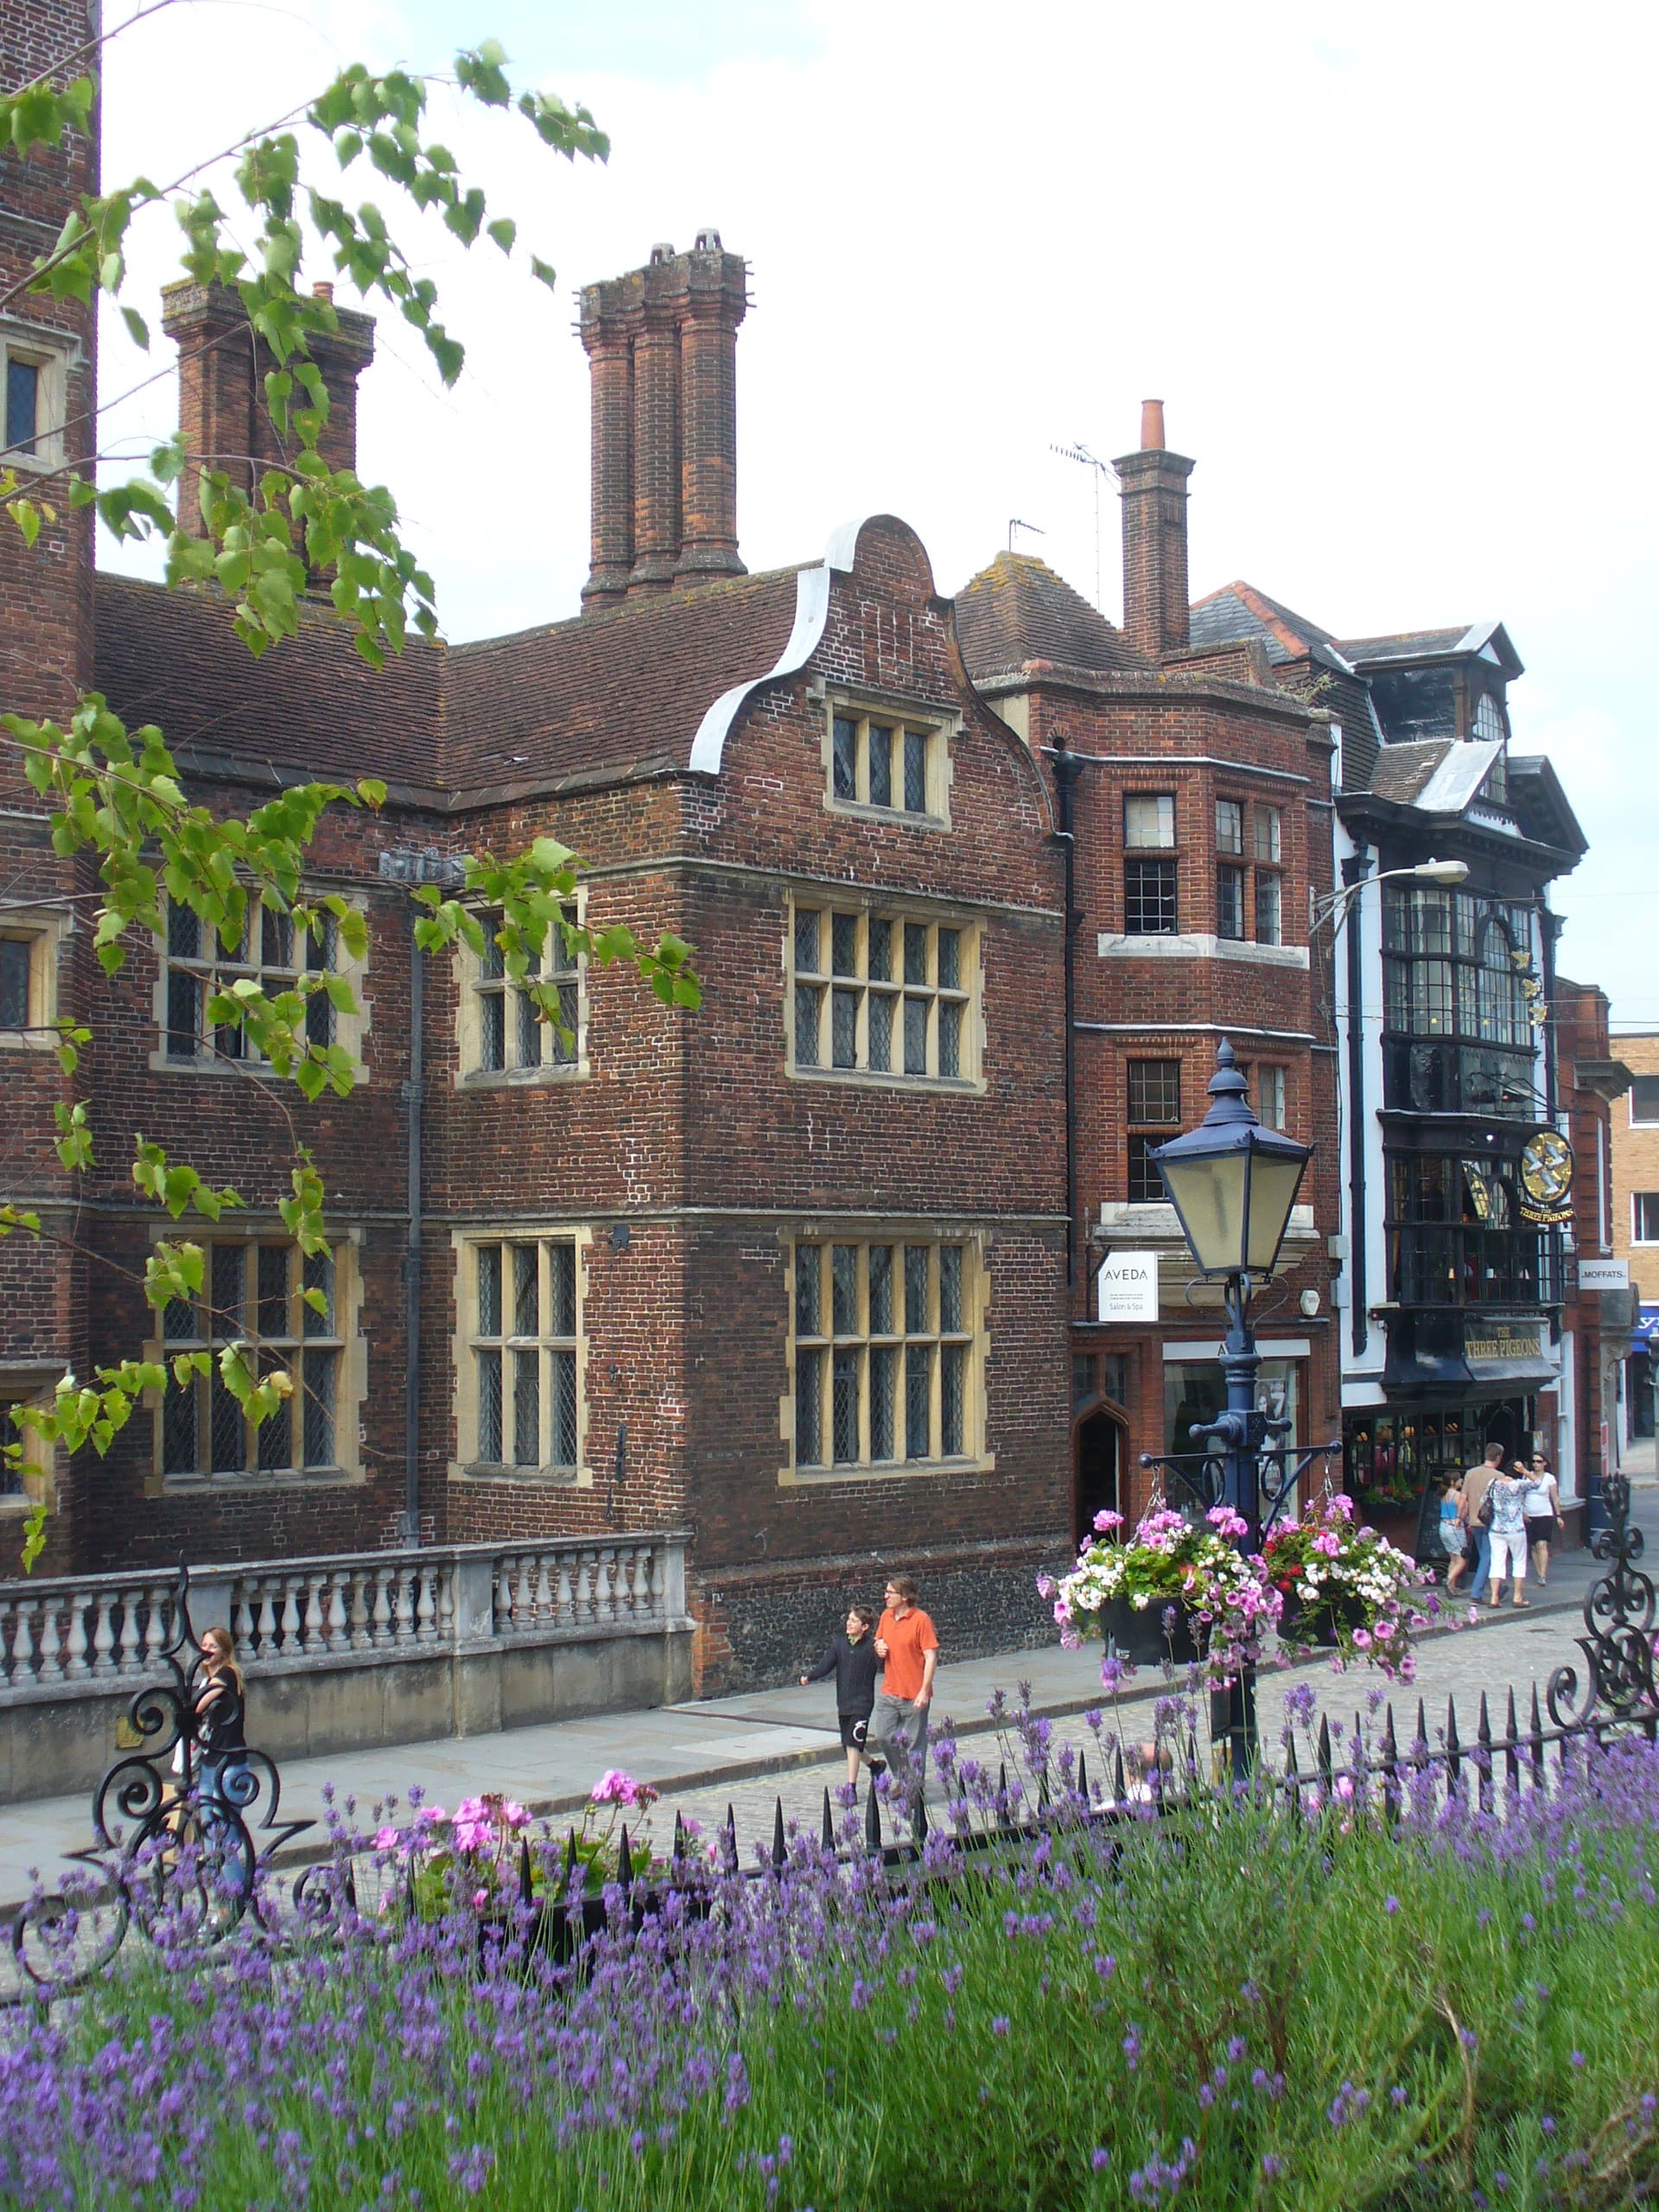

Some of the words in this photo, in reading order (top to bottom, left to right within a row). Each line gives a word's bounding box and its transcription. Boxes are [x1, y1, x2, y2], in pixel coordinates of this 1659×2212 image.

[1521, 1206, 1542, 1222] THREE
[1542, 1209, 1573, 1222] PIGEONS
[1104, 1269, 1148, 1280] AVEDA
[1132, 1302, 1142, 1311] Spa
[1497, 1326, 1510, 1338] THE
[1465, 1340, 1497, 1358] THREE
[1499, 1338, 1541, 1357] PIGEONS
